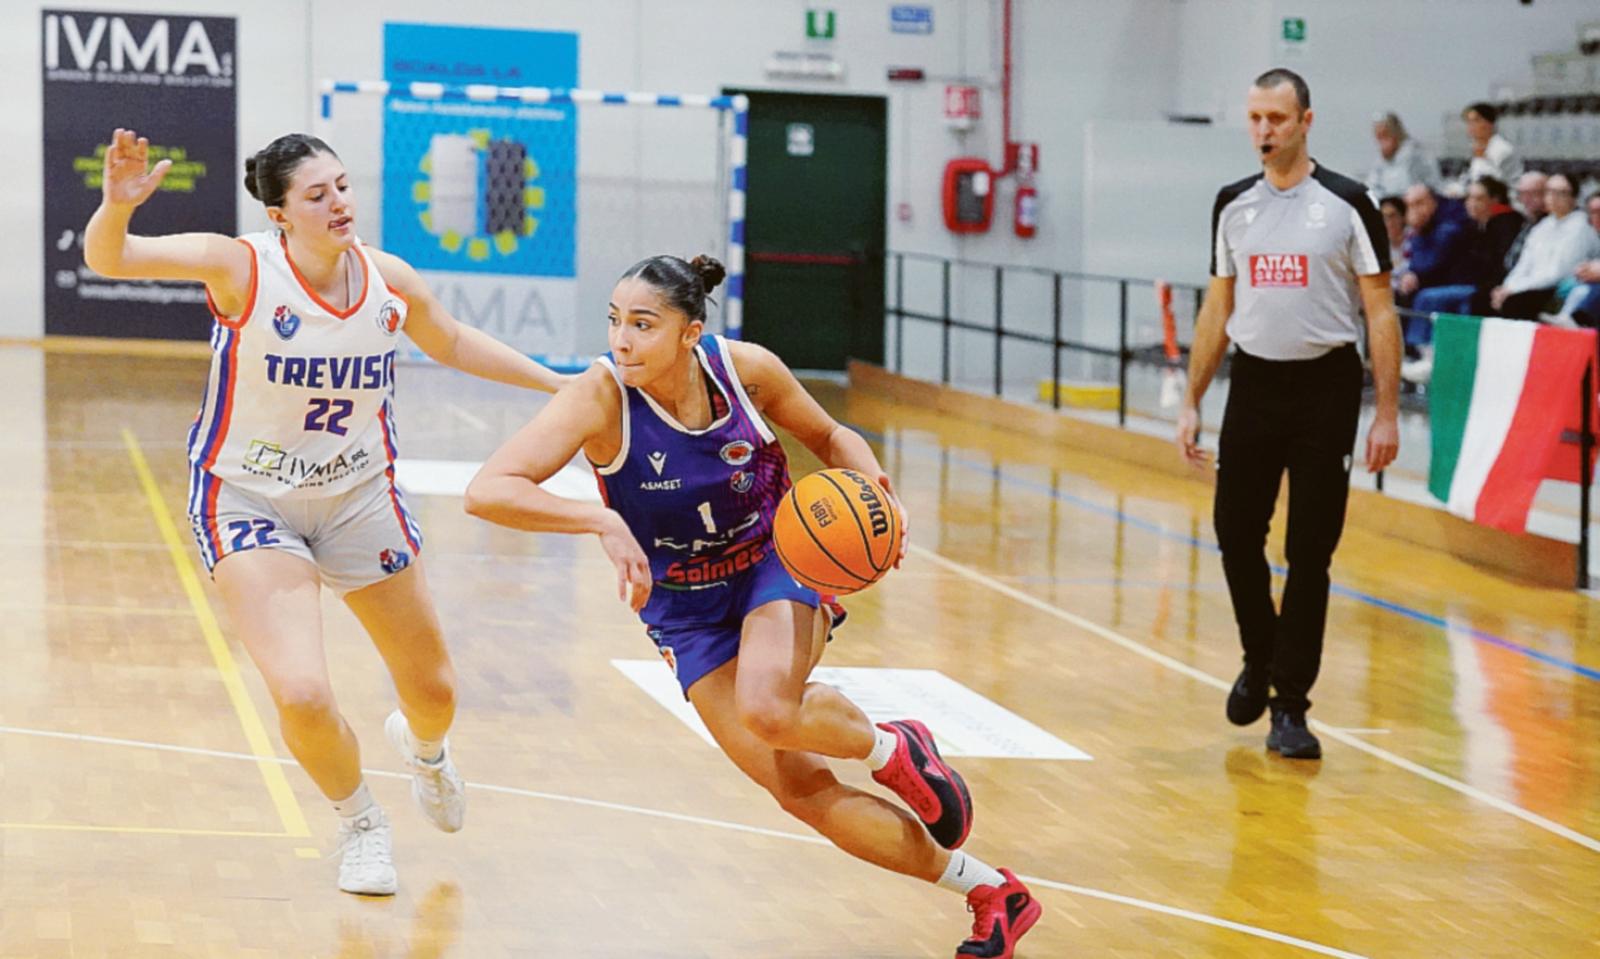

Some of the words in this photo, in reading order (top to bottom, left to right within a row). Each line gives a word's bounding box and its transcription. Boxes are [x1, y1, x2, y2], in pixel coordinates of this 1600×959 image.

[303, 398, 354, 437] 22
[697, 501, 718, 534] 1
[228, 518, 281, 552] 22
